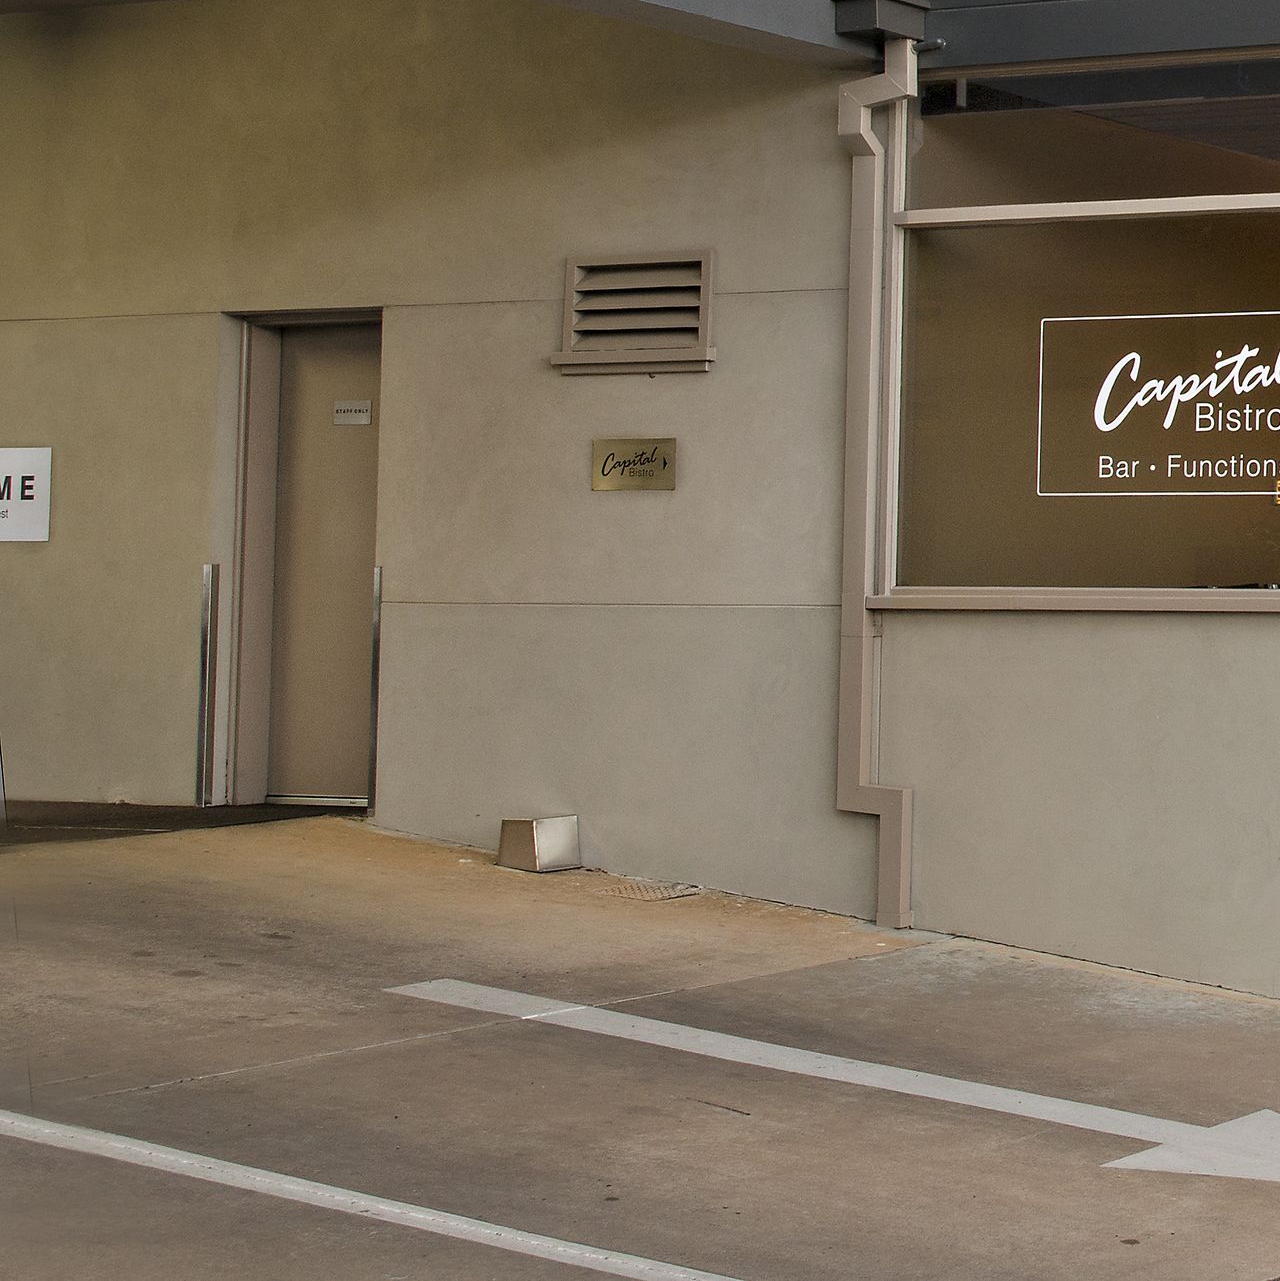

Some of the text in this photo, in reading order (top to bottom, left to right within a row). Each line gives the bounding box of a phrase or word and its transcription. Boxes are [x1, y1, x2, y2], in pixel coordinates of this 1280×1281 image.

[601, 446, 658, 476] Capital
[629, 467, 655, 477] Bistro
[1098, 455, 1140, 478] Bar
